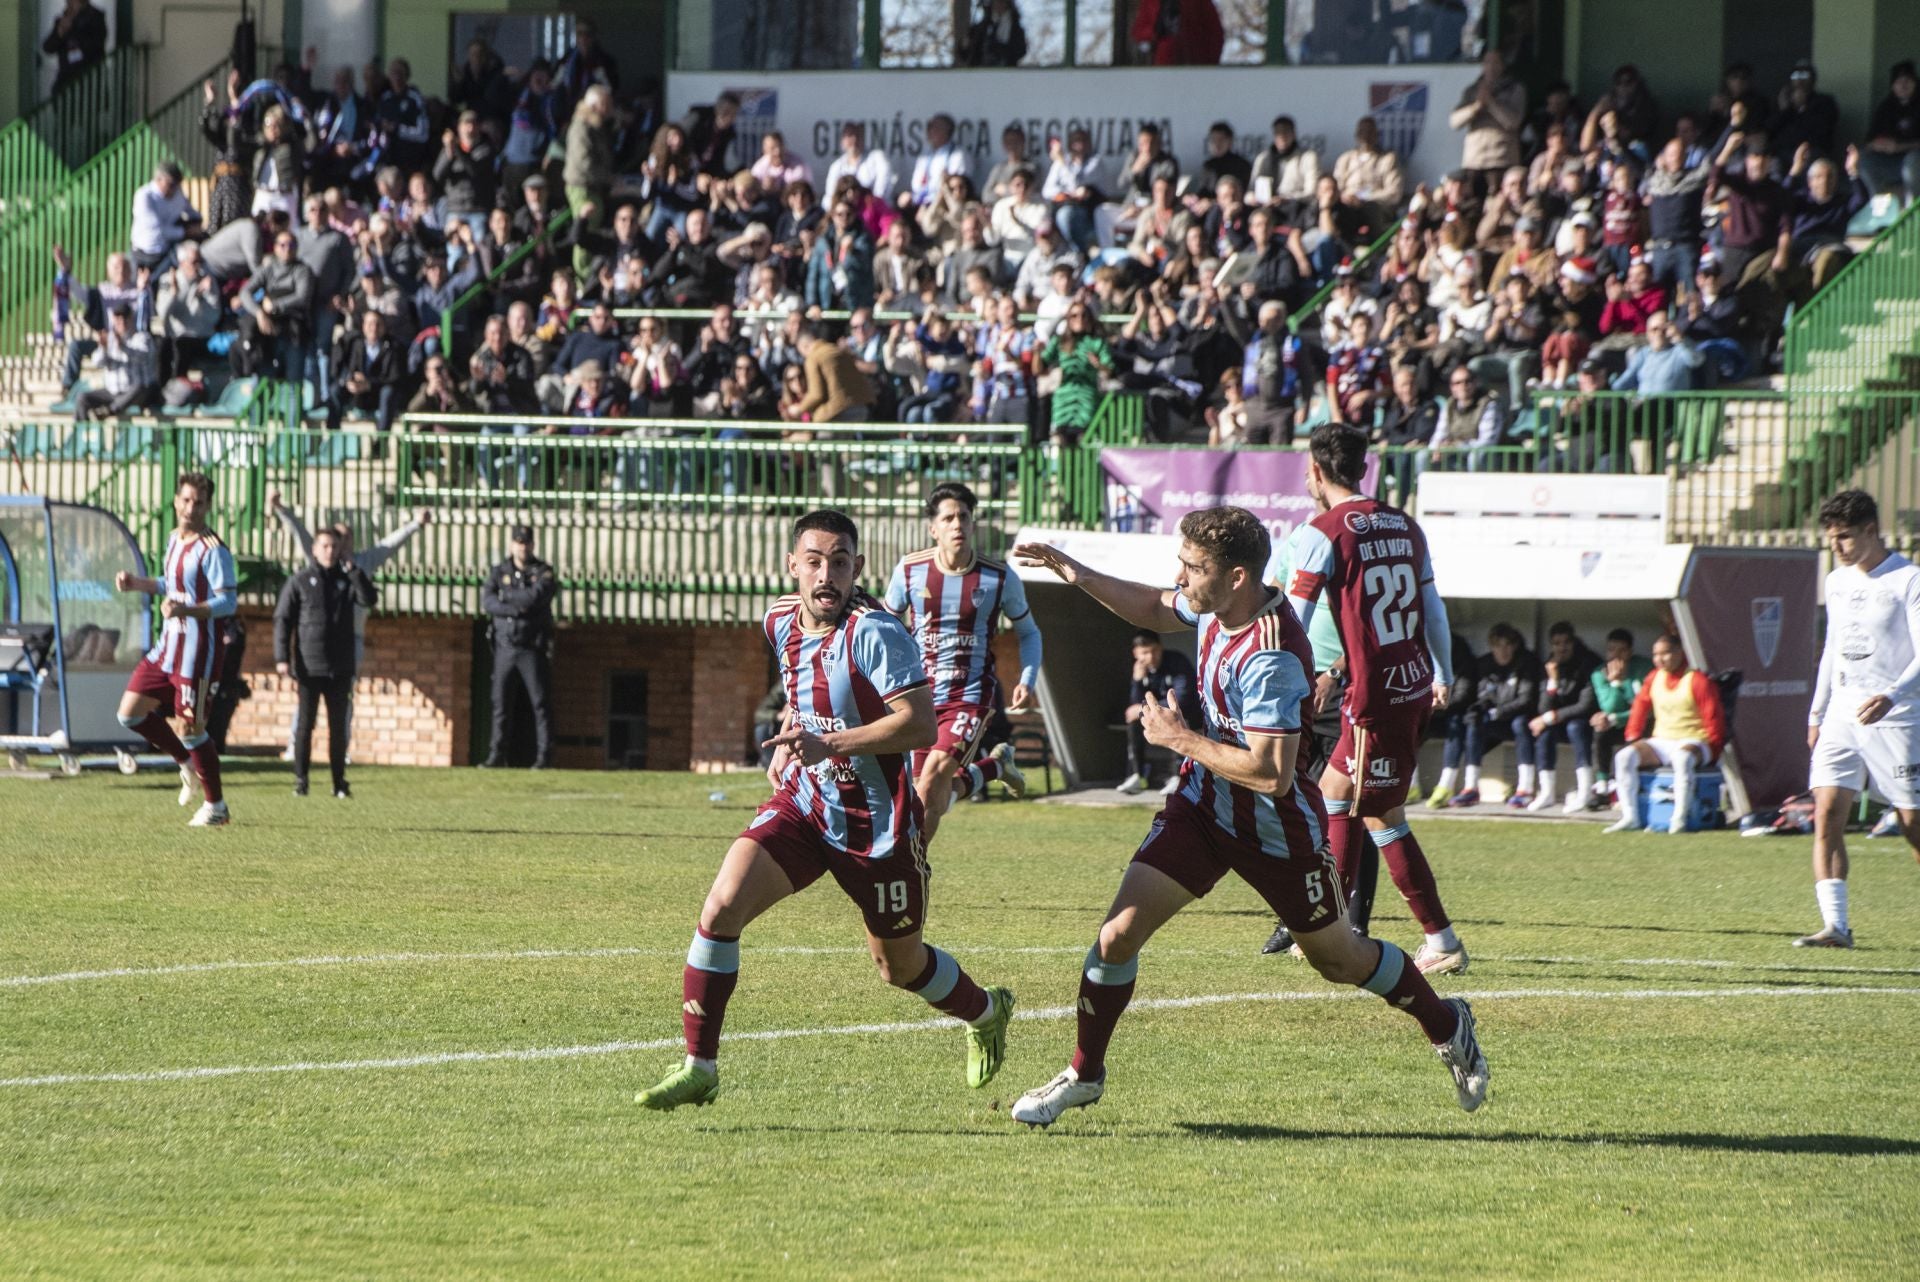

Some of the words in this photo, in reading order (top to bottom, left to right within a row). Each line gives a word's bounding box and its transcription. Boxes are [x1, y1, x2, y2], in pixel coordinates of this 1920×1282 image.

[1359, 541, 1376, 562] DE
[1374, 539, 1388, 558] LA
[1387, 537, 1413, 557] MATA
[1364, 563, 1419, 647] 22
[180, 683, 196, 708] 14
[950, 711, 981, 742] 23
[874, 880, 908, 913] 19
[1305, 869, 1324, 904] 5
